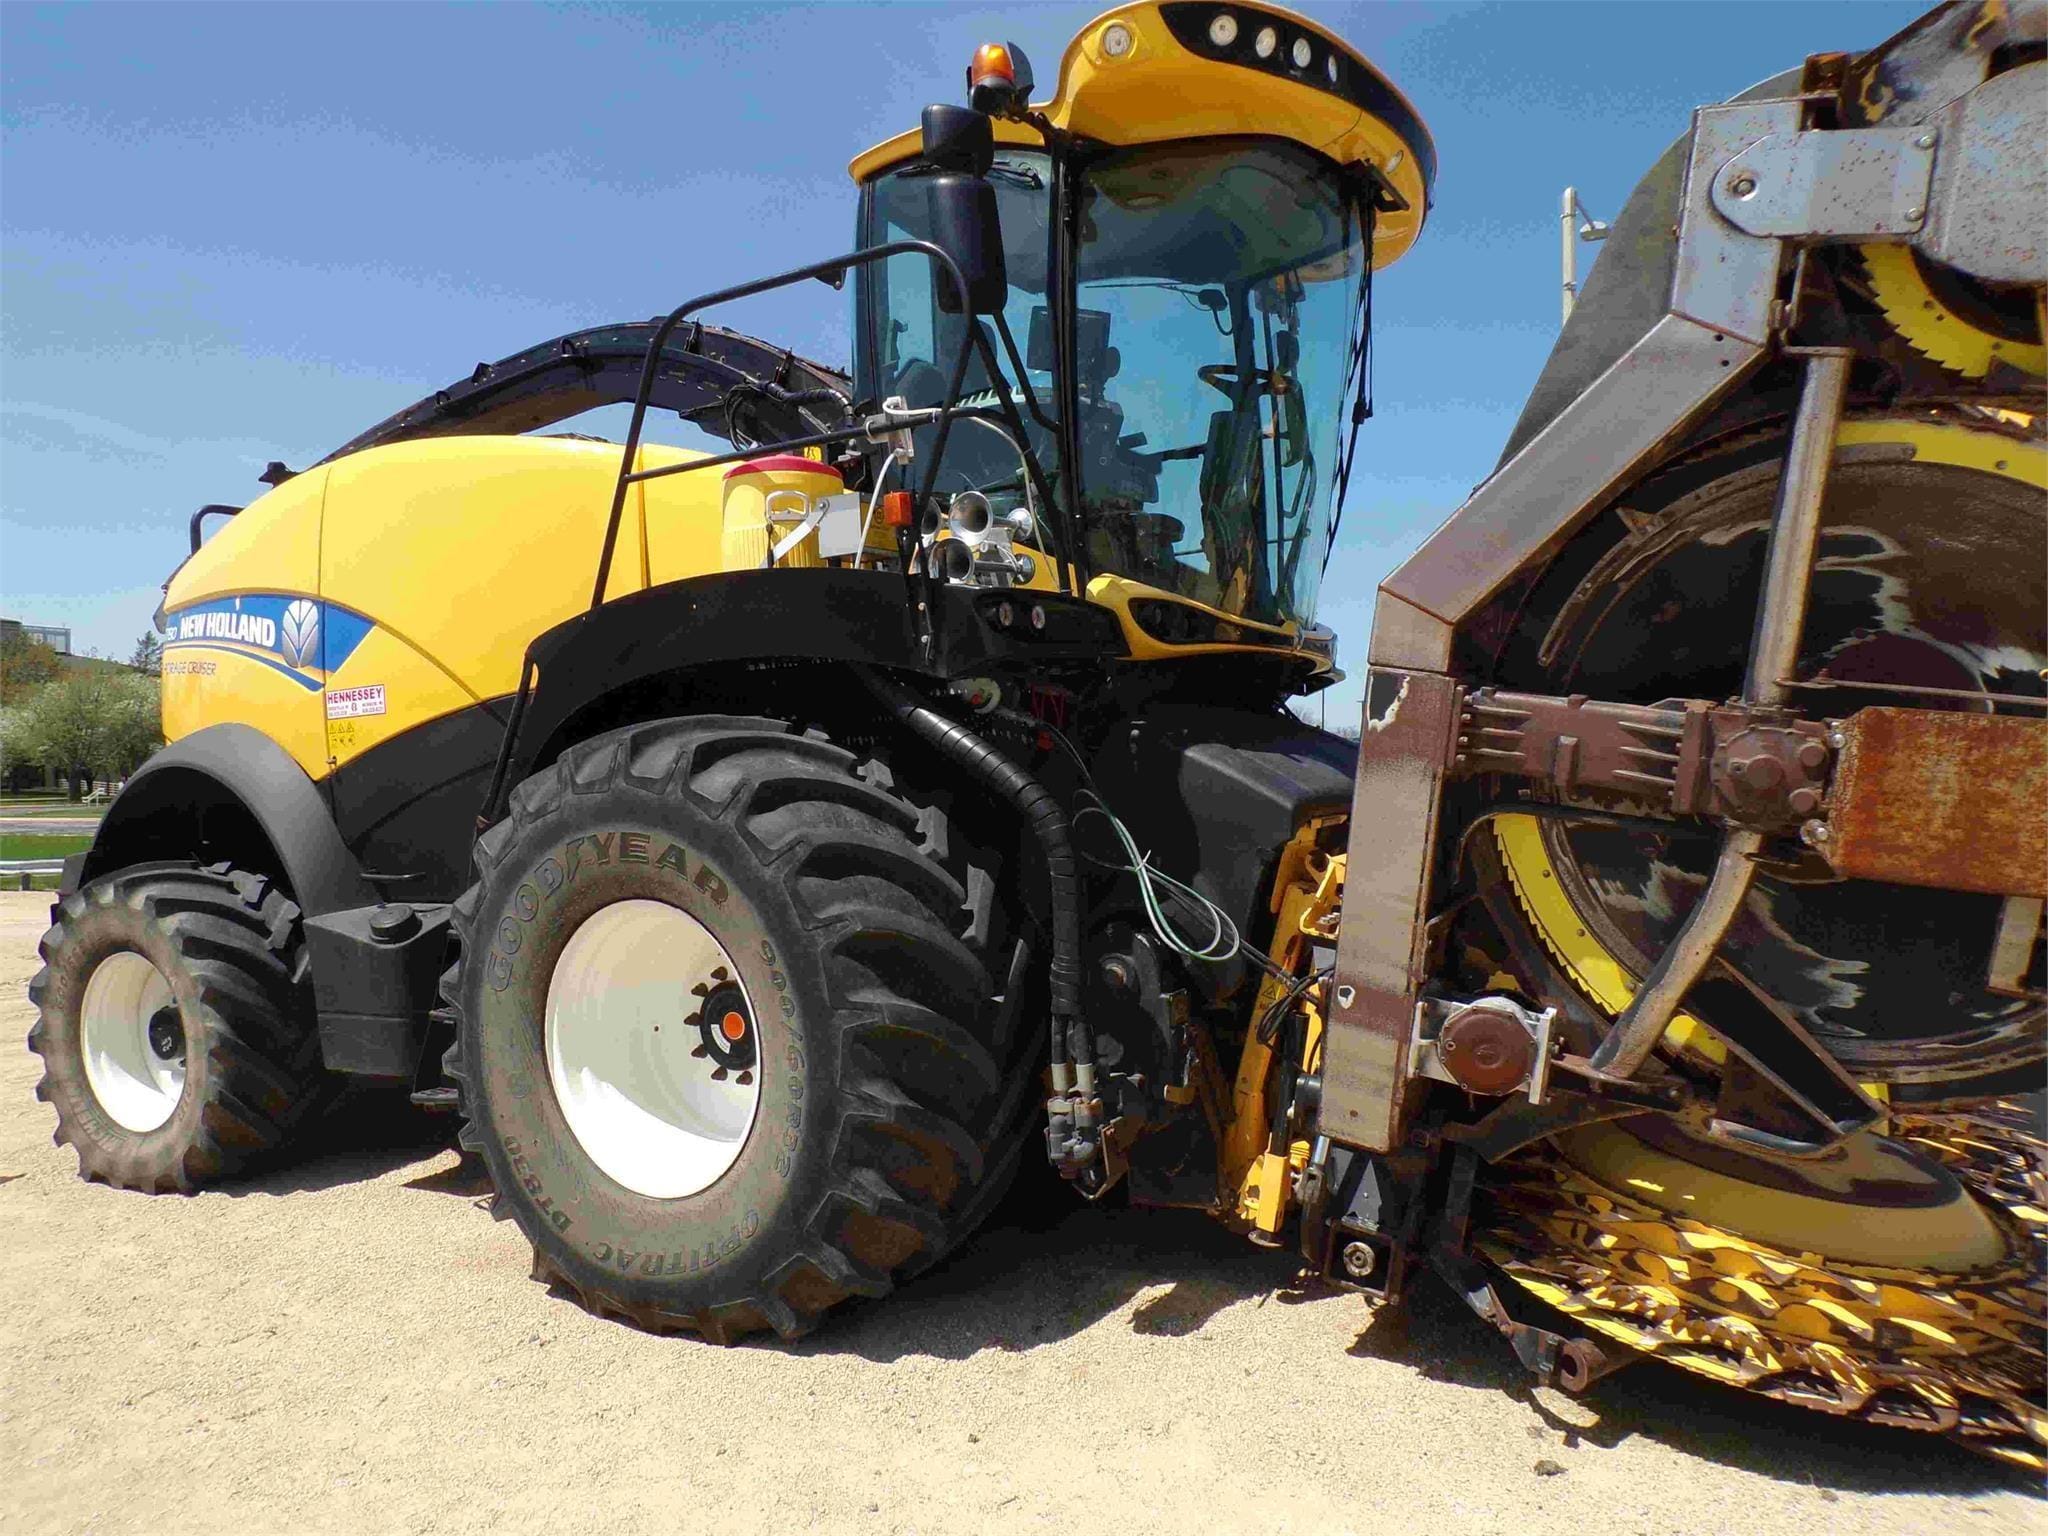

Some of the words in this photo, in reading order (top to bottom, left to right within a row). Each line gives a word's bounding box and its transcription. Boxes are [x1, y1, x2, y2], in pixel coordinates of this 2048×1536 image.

[180, 613, 206, 639] NEW
[206, 612, 276, 647] HOLLAND
[327, 687, 382, 705] HENNESSEY
[488, 831, 730, 993] GOODYEAR
